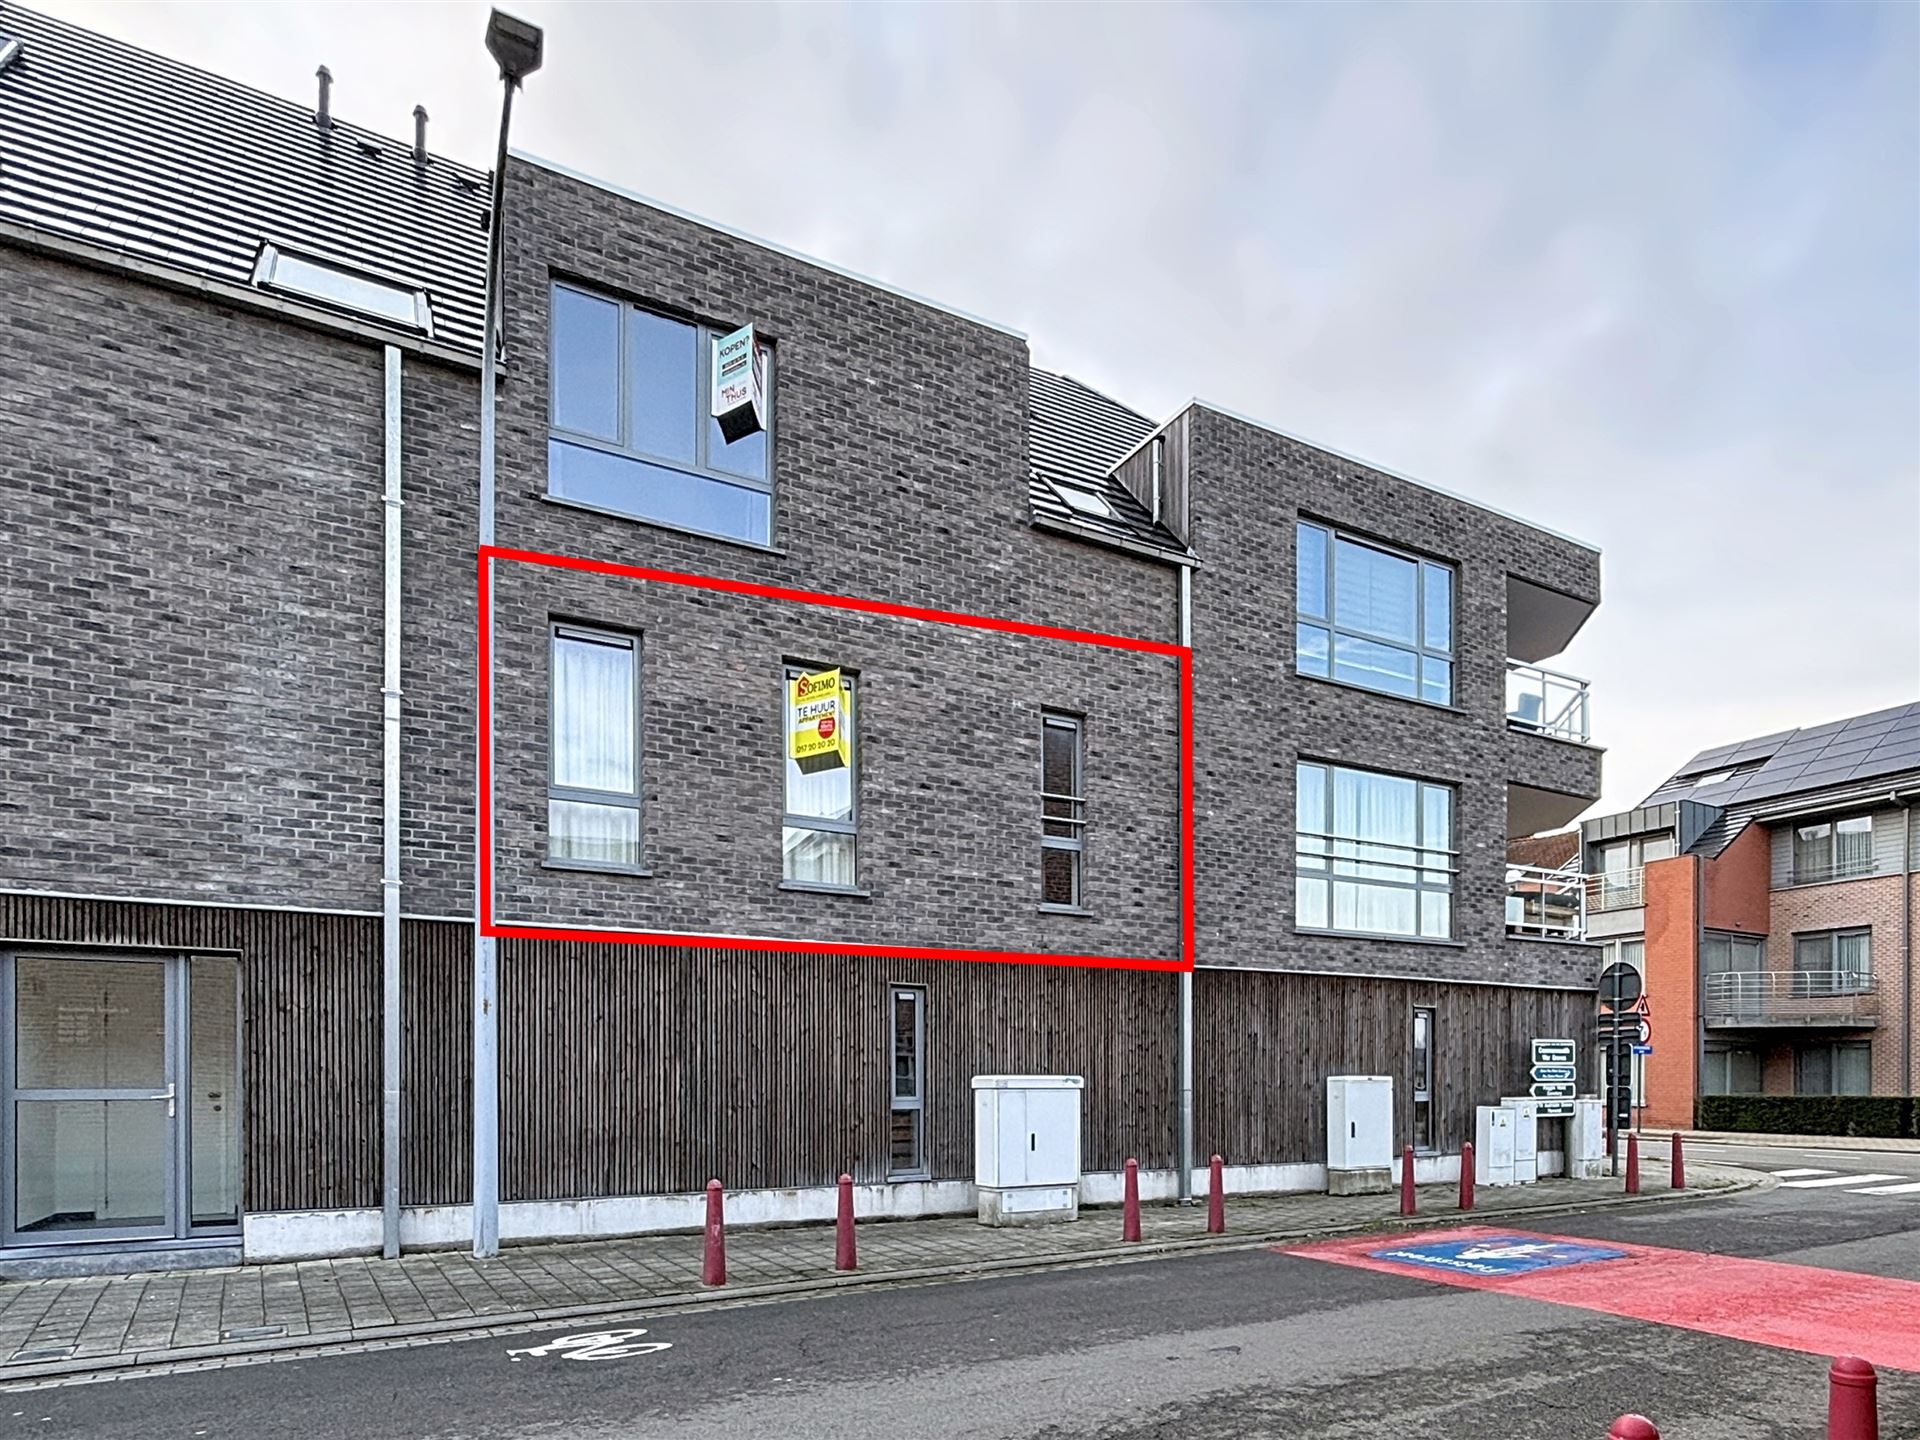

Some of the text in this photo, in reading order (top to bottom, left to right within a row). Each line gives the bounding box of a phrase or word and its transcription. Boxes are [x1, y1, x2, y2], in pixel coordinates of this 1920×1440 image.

[720, 335, 749, 359] KOPEN?
[799, 677, 835, 696] SOFIMO
[798, 700, 835, 718] TE HUUR
